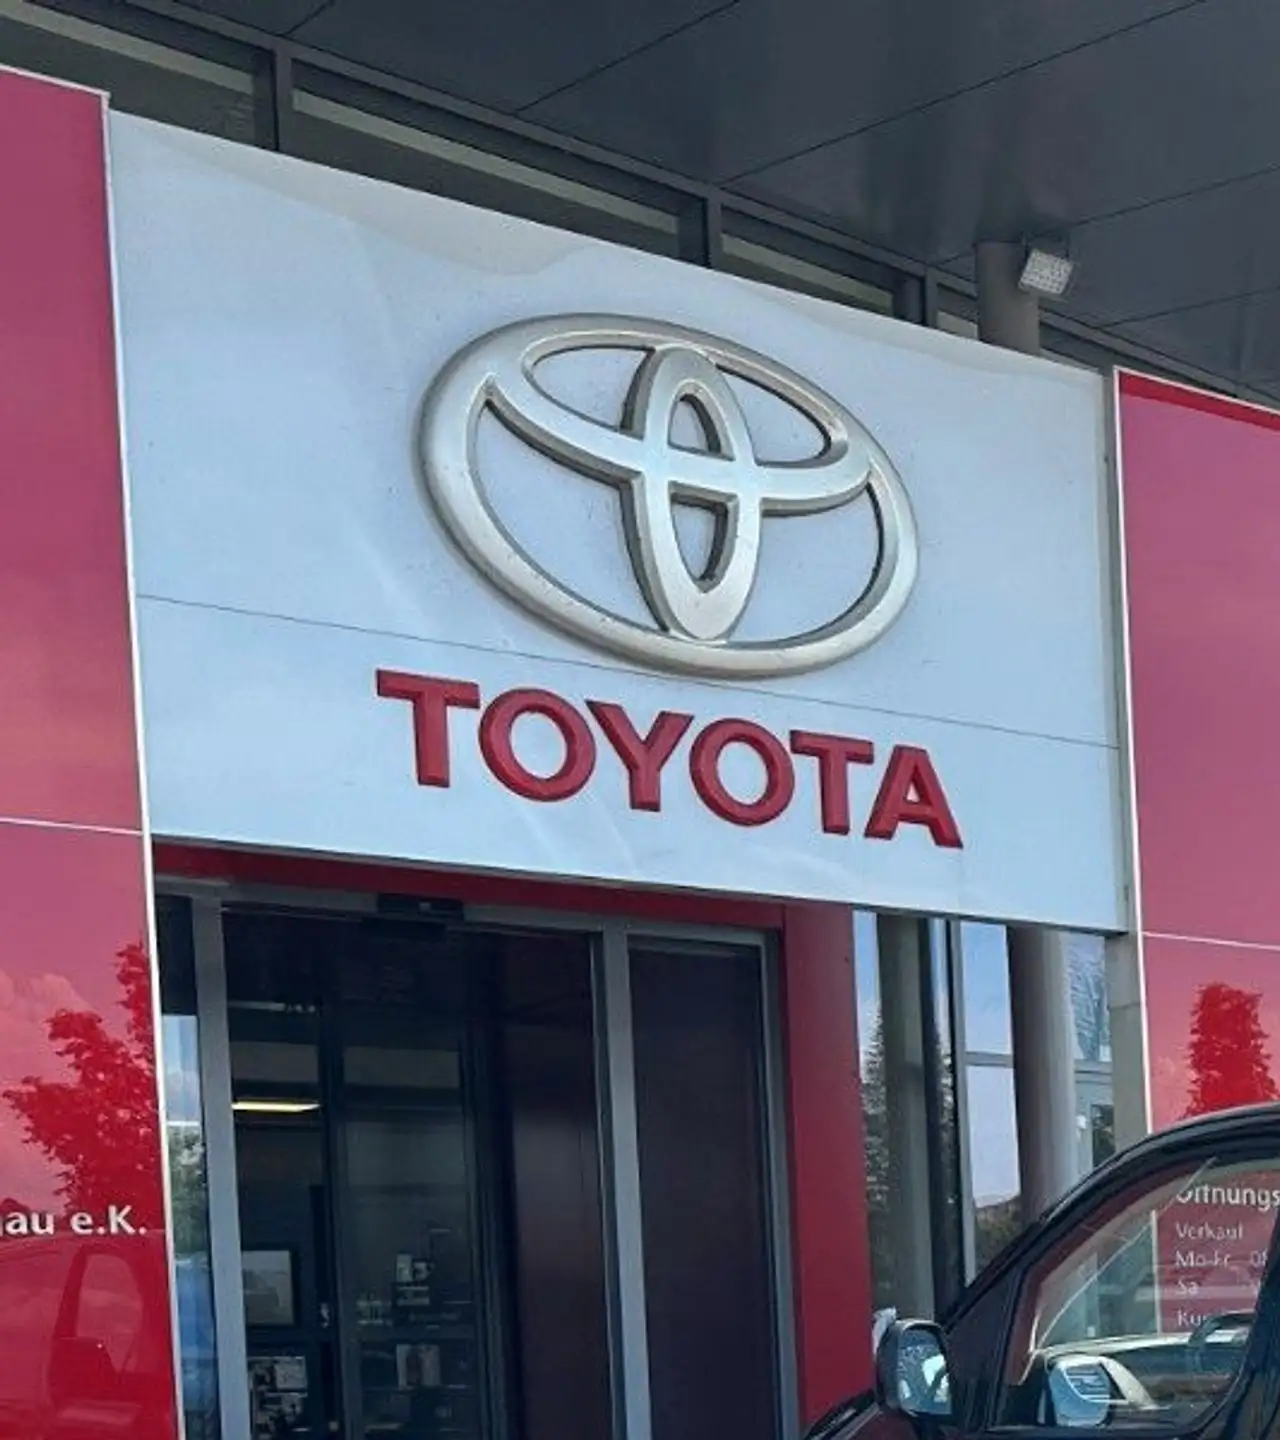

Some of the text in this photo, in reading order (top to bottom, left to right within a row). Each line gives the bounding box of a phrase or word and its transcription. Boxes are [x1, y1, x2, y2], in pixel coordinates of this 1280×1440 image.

[376, 669, 963, 849] TOYOTA
[0, 1204, 147, 1236] au e.K.
